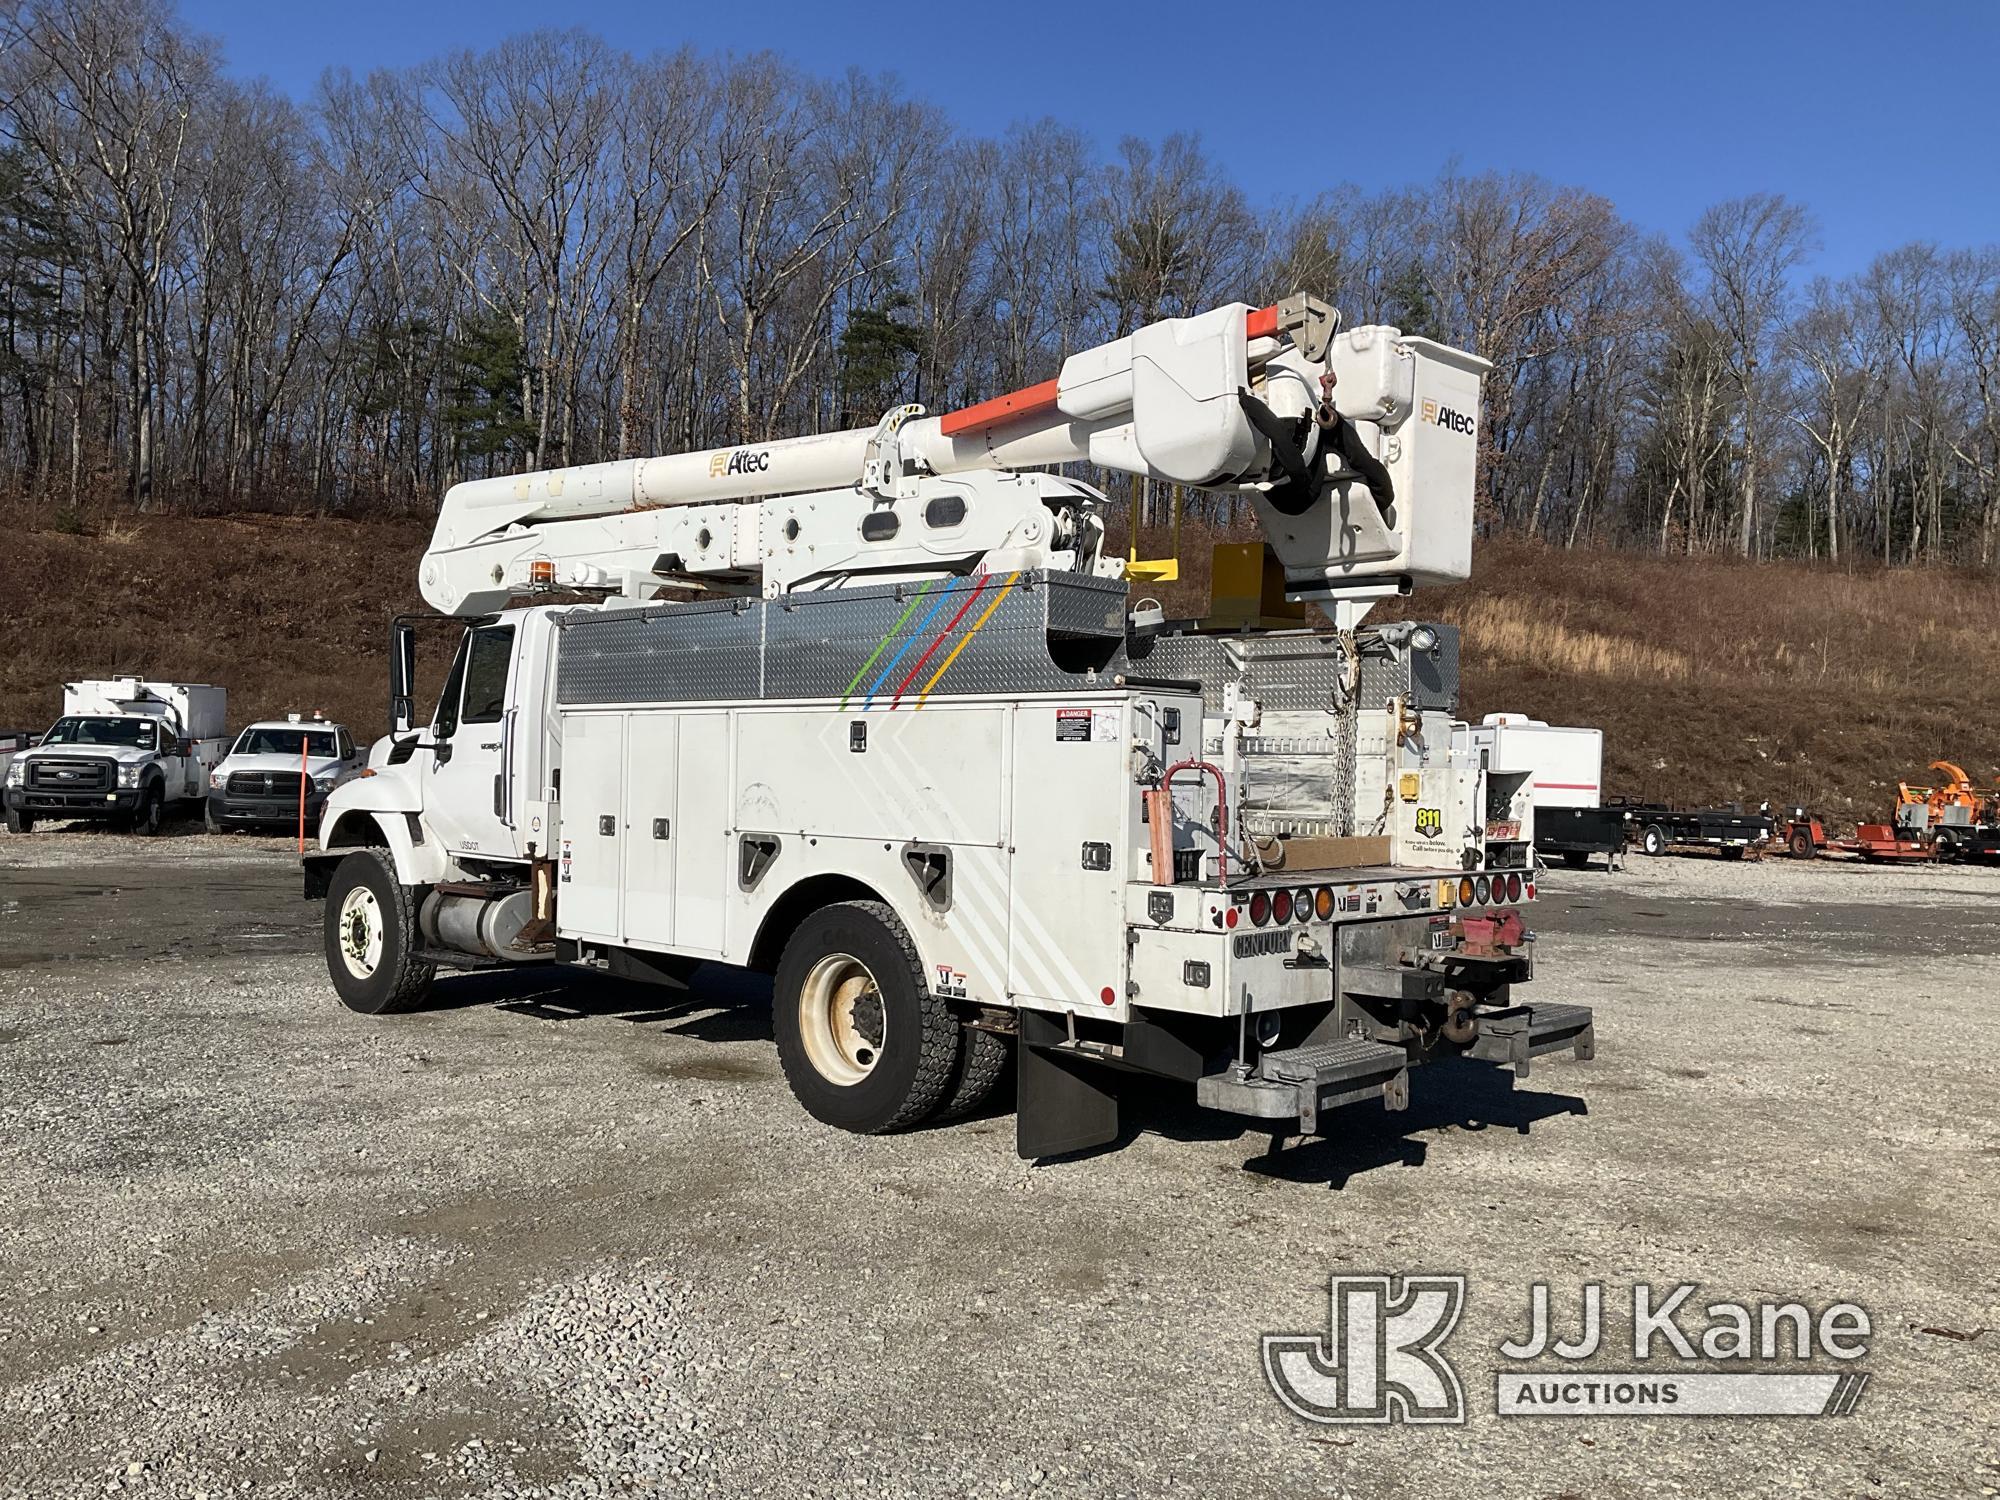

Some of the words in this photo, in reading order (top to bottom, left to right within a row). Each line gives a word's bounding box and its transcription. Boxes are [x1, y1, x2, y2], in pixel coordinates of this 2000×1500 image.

[1437, 406, 1474, 435] Altec
[728, 450, 769, 475] Altec
[1066, 710, 1088, 718] DANGER
[1416, 808, 1441, 828] 811
[459, 840, 480, 851] USDOT
[1233, 930, 1292, 959] CENTURY
